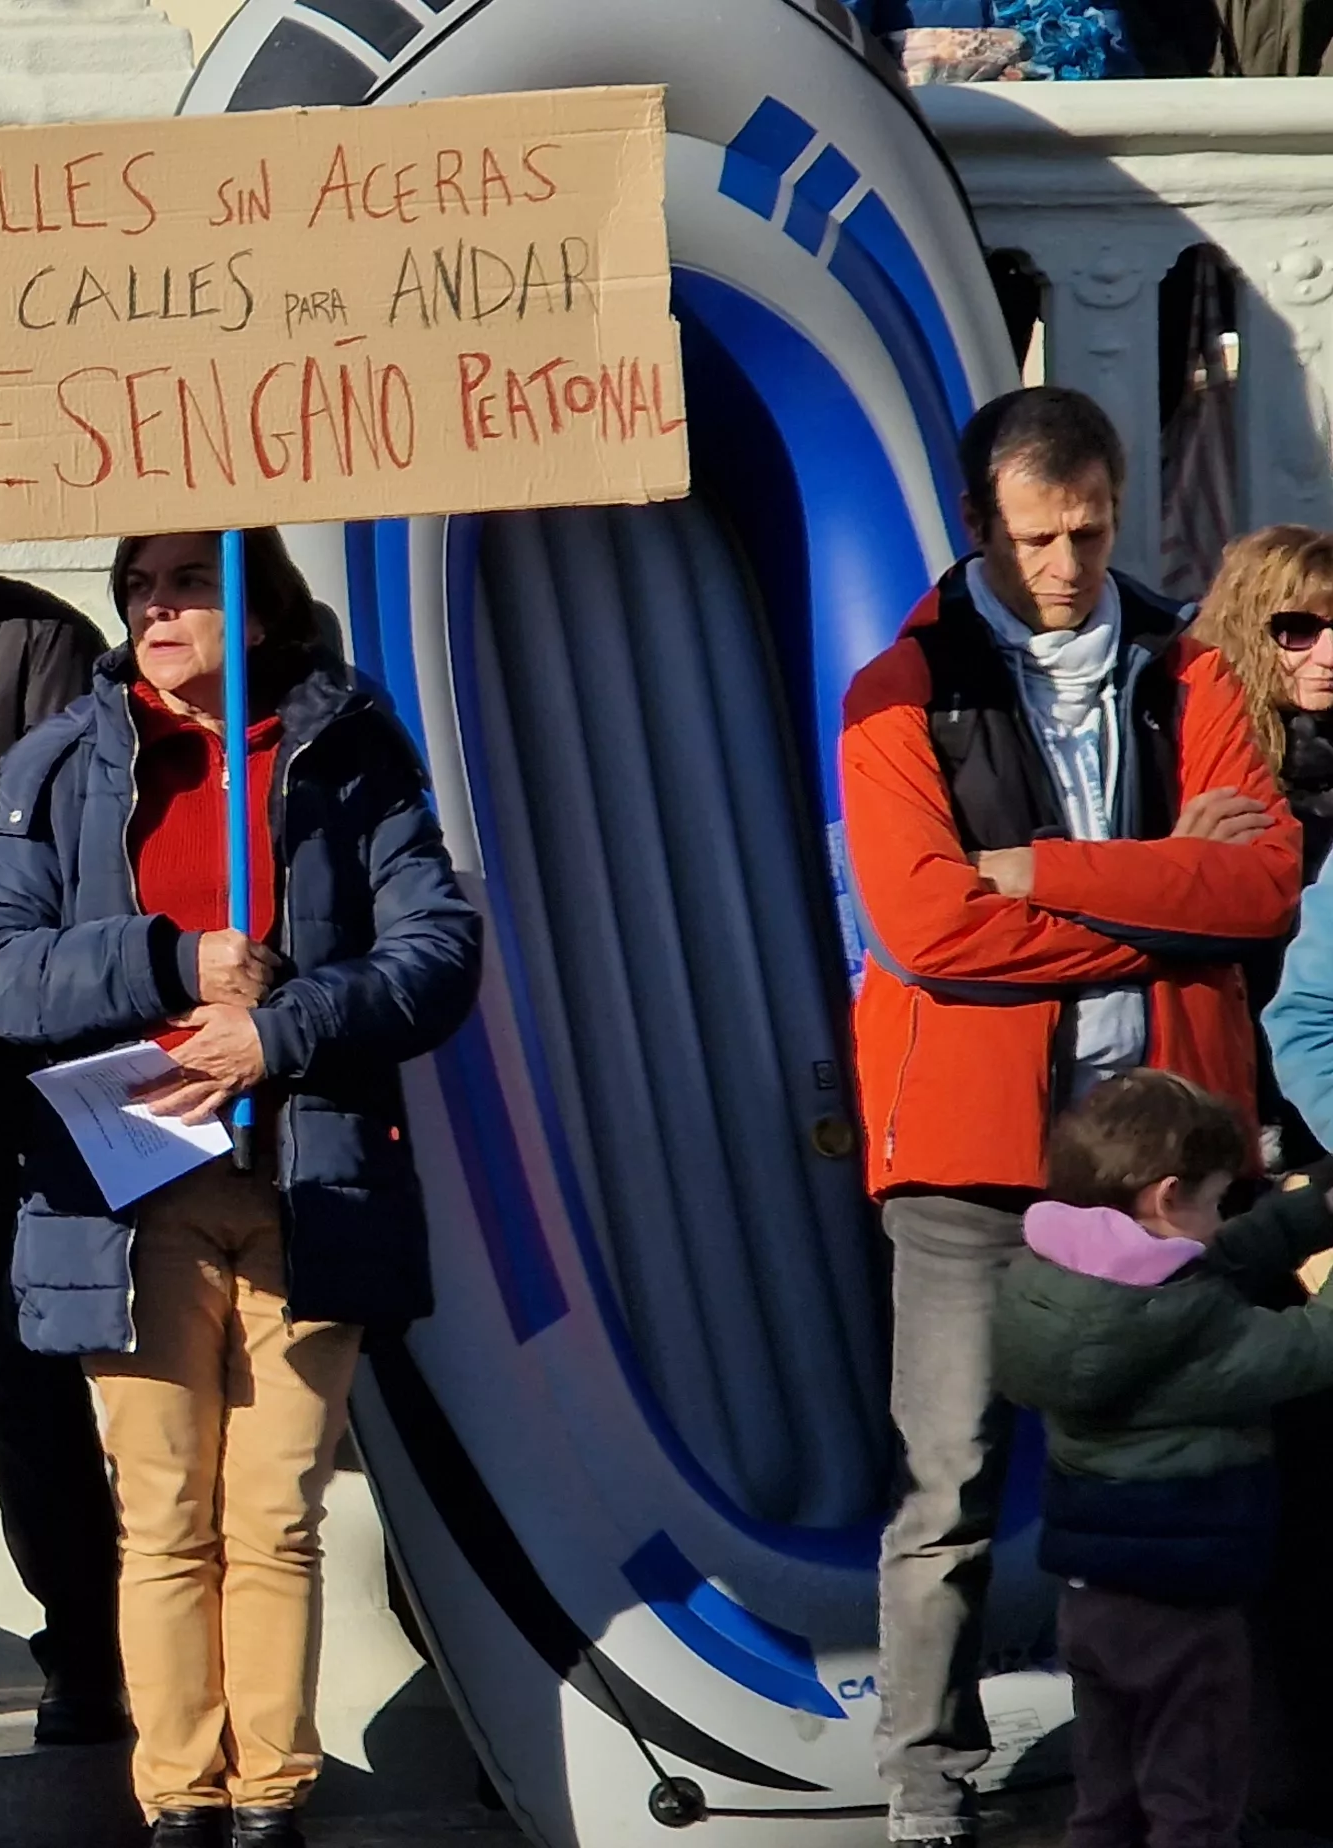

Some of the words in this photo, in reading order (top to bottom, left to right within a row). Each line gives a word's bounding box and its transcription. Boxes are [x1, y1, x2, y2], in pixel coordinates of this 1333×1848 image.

[208, 157, 272, 227] SIN
[307, 142, 563, 229] ACERAS
[17, 247, 255, 332] CALLES
[284, 287, 349, 339] PARA
[388, 235, 600, 330] ANDAR
[457, 351, 687, 452] PEATONAL
